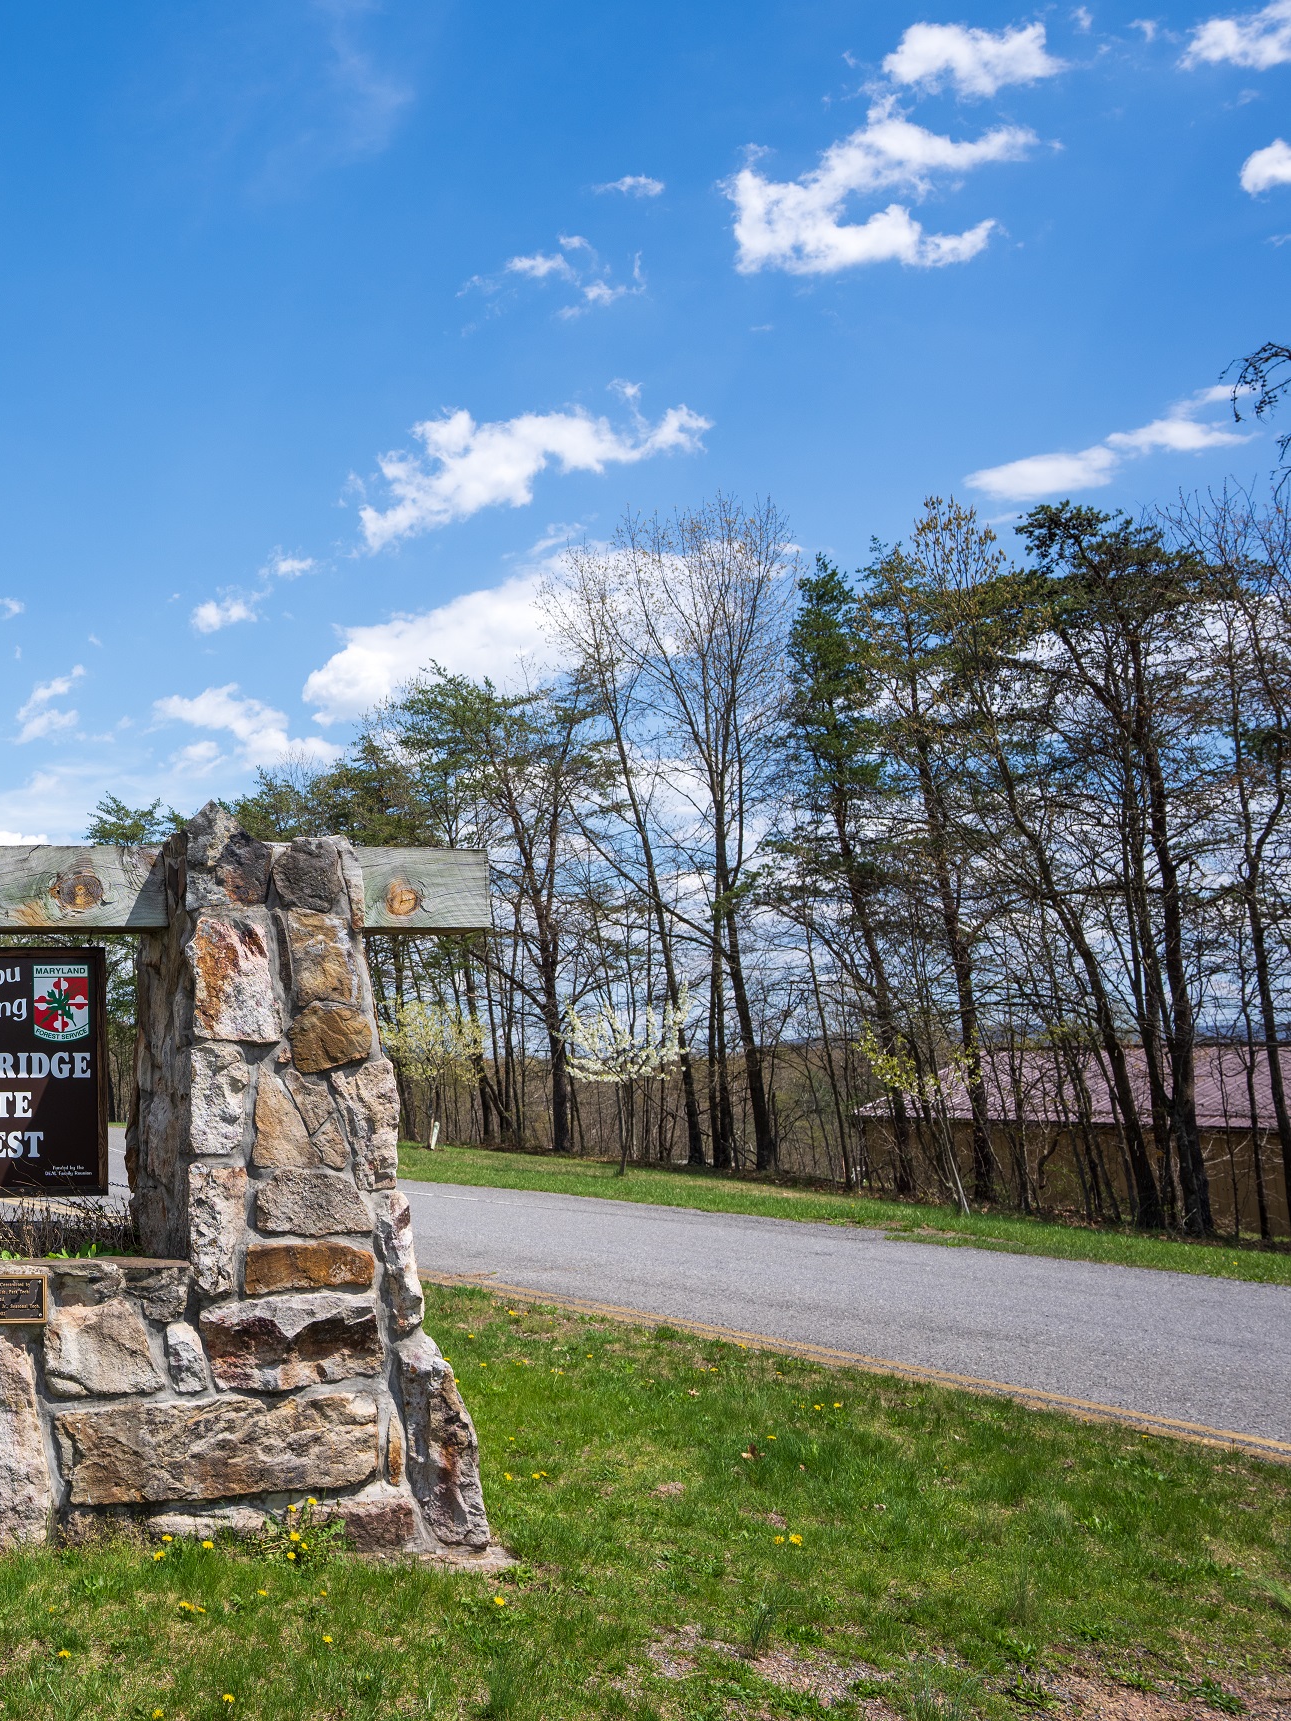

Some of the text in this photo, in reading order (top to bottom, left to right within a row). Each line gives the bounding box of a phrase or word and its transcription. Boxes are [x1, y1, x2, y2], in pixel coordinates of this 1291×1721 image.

[35, 967, 86, 975] MARYLAND
[35, 1027, 88, 1040] FOREST SERVICE
